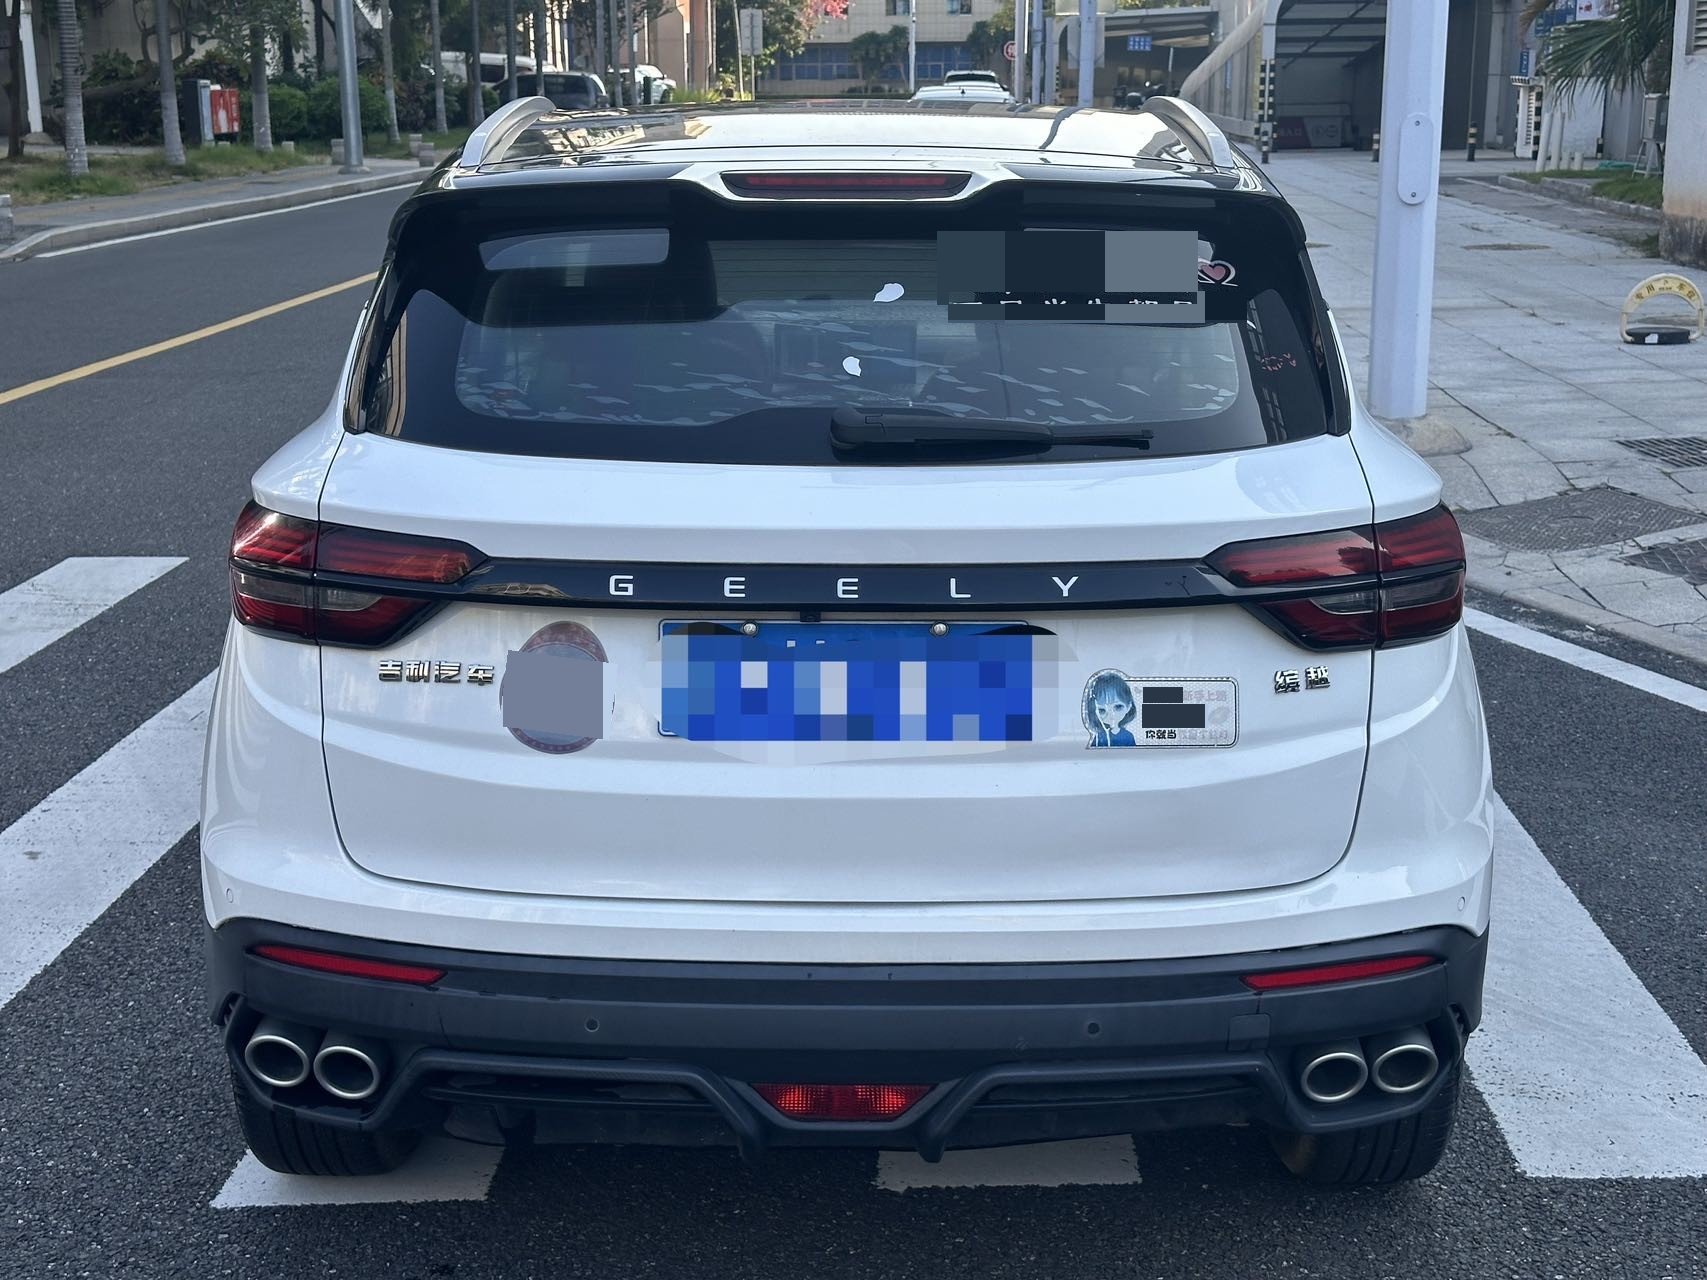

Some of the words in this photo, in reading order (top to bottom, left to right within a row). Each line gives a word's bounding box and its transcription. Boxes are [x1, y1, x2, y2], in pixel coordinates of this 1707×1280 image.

[609, 574, 1078, 599] GEELY
[379, 660, 494, 686] 吉利汽车
[1275, 666, 1331, 693] 缤越
